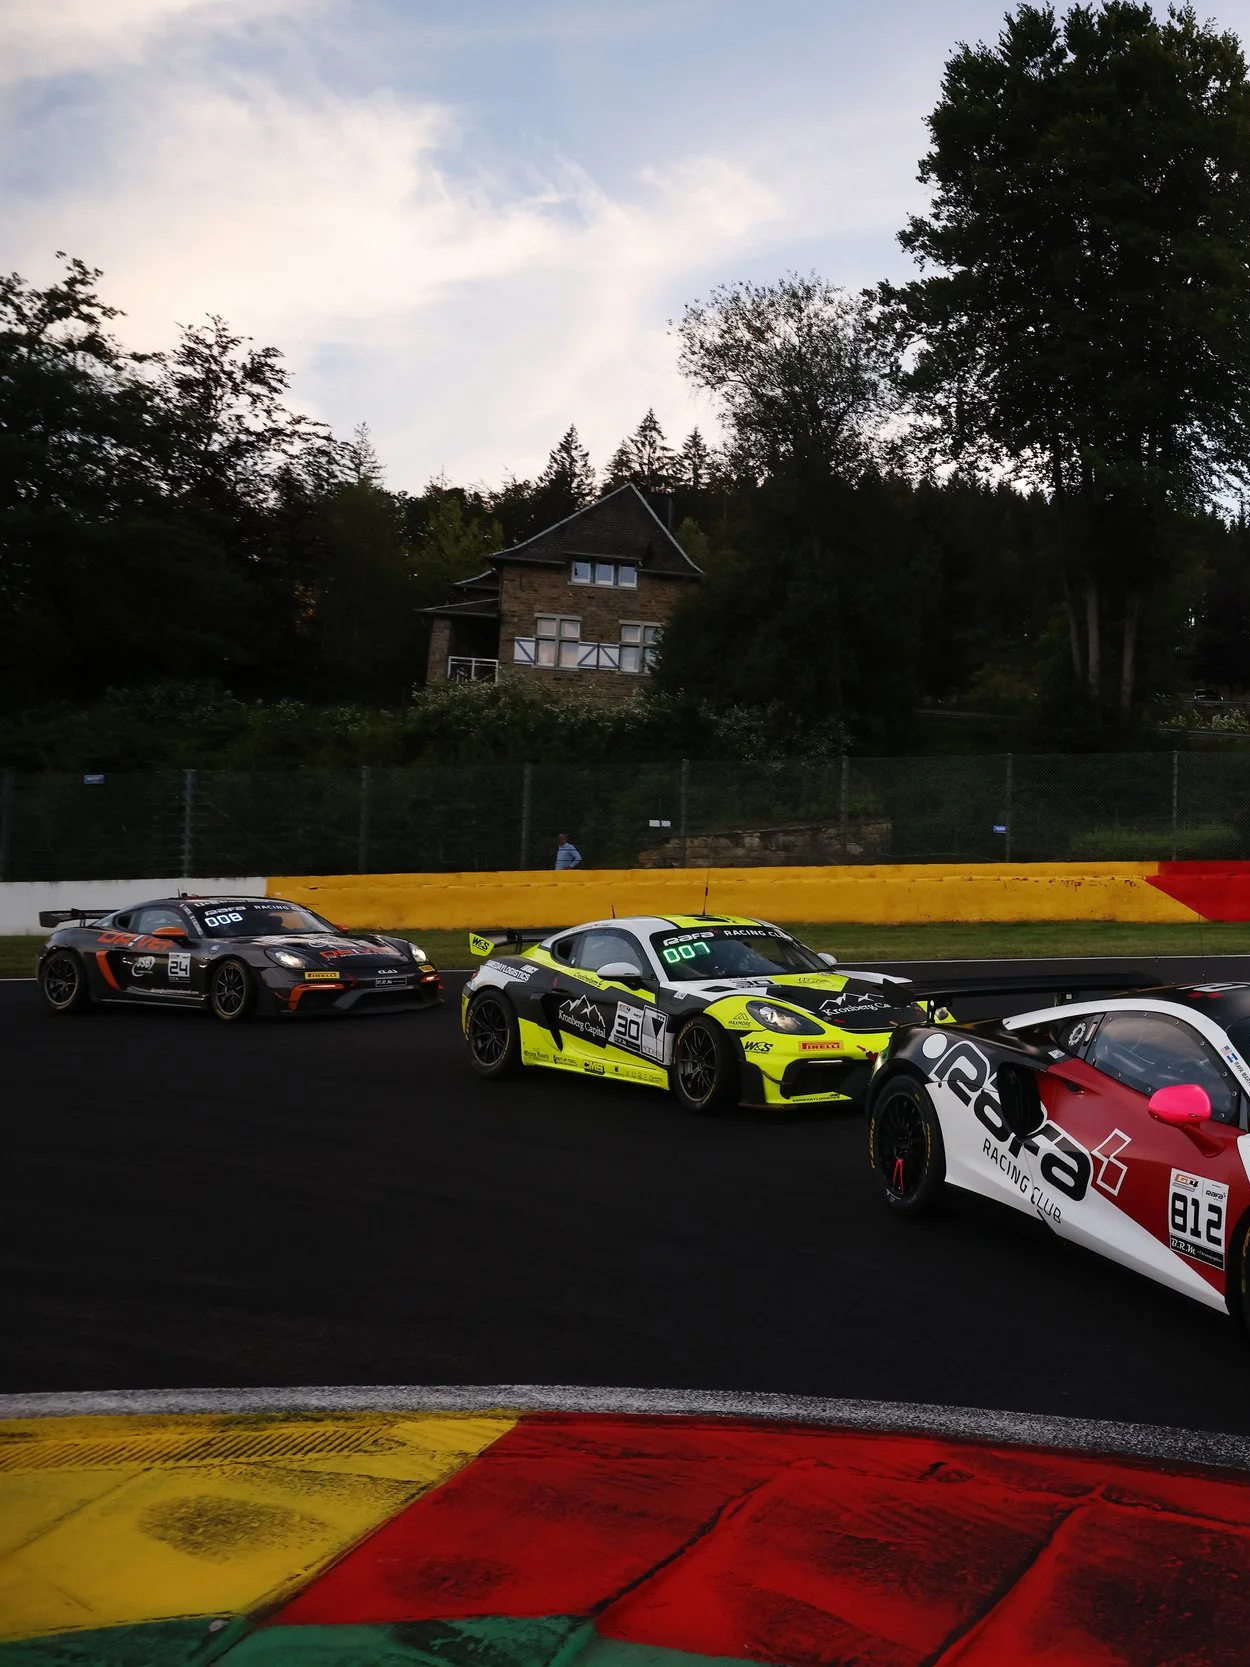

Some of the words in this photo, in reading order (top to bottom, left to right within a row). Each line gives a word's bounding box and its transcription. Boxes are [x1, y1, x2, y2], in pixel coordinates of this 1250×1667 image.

[204, 912, 243, 927] 008
[662, 942, 711, 964] 007
[170, 961, 188, 975] 24
[821, 1004, 878, 1016] Kronberg
[558, 1009, 585, 1032] Kronberg
[584, 1022, 606, 1040] Capital
[616, 1014, 640, 1042] 30
[982, 1137, 1029, 1193] RACING
[1031, 1186, 1063, 1225] CLUB
[1171, 1192, 1223, 1247] 812
